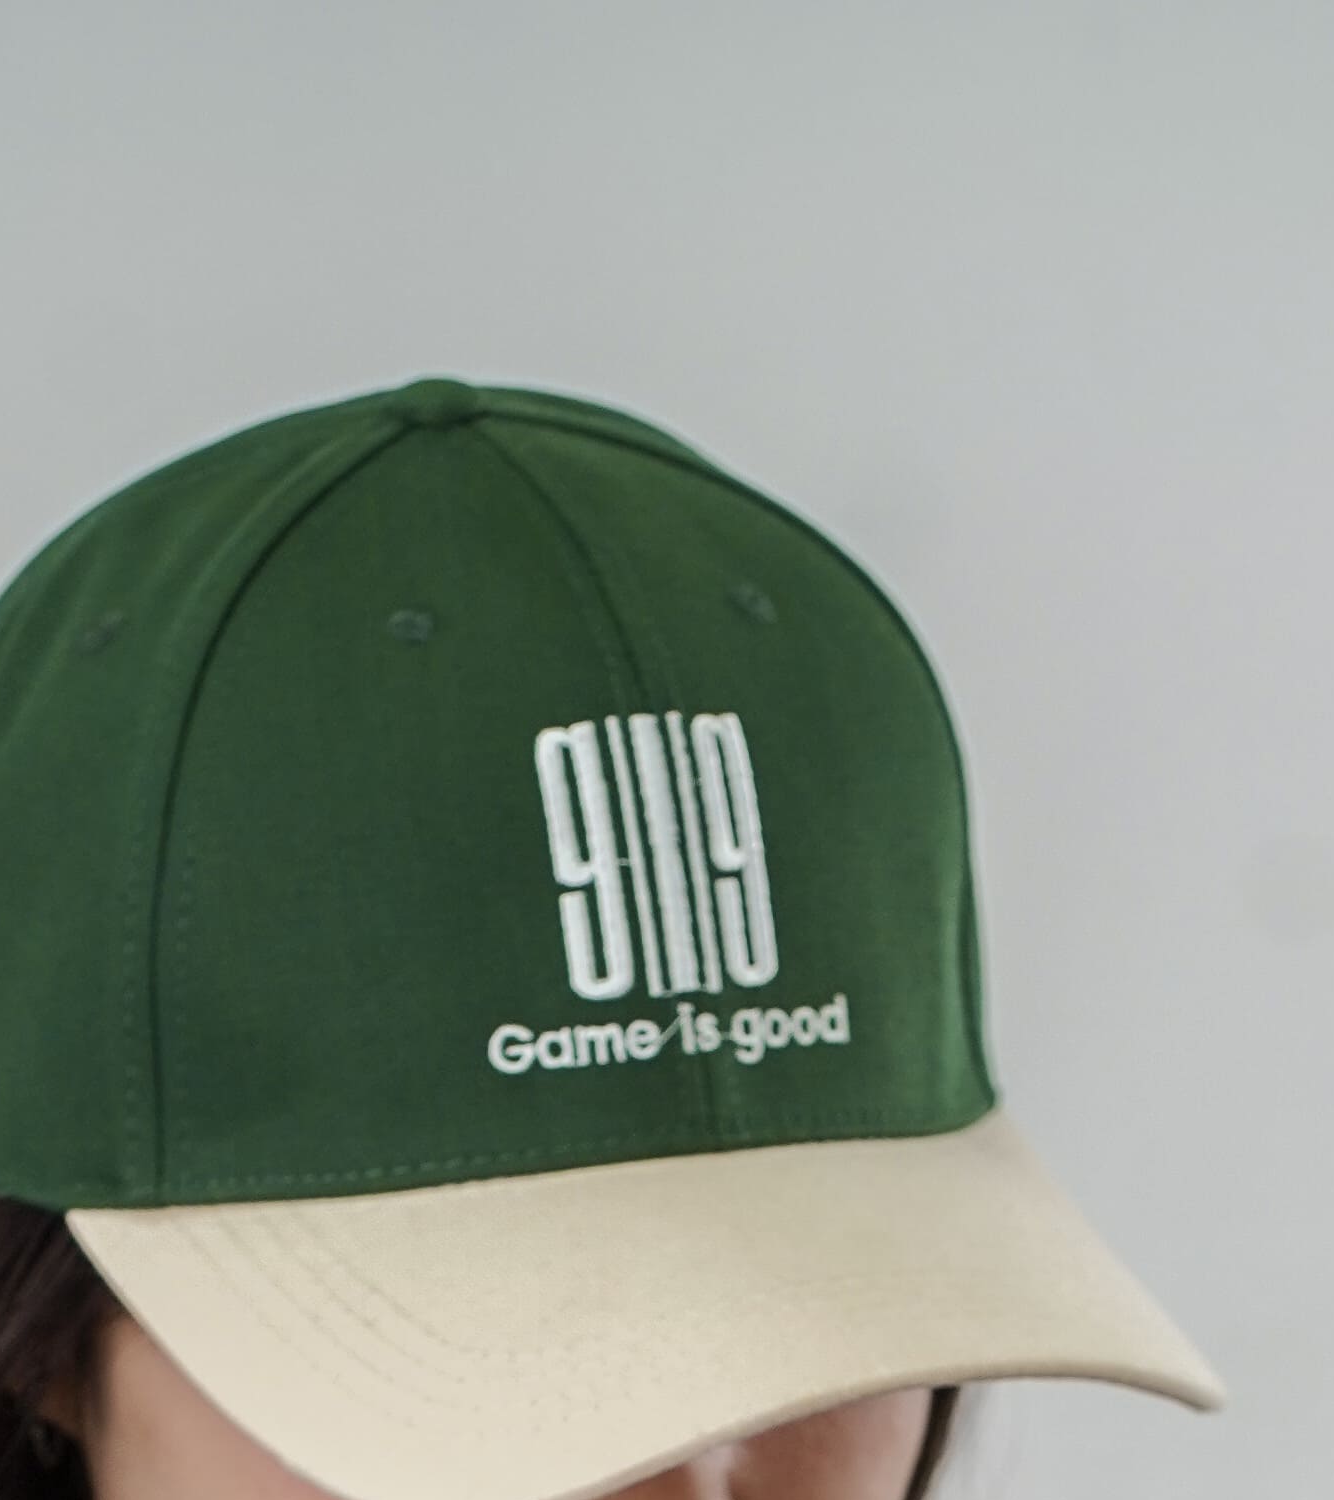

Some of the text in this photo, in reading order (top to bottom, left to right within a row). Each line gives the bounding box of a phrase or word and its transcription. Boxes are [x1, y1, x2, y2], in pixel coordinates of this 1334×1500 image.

[487, 994, 850, 1074] Game is good
